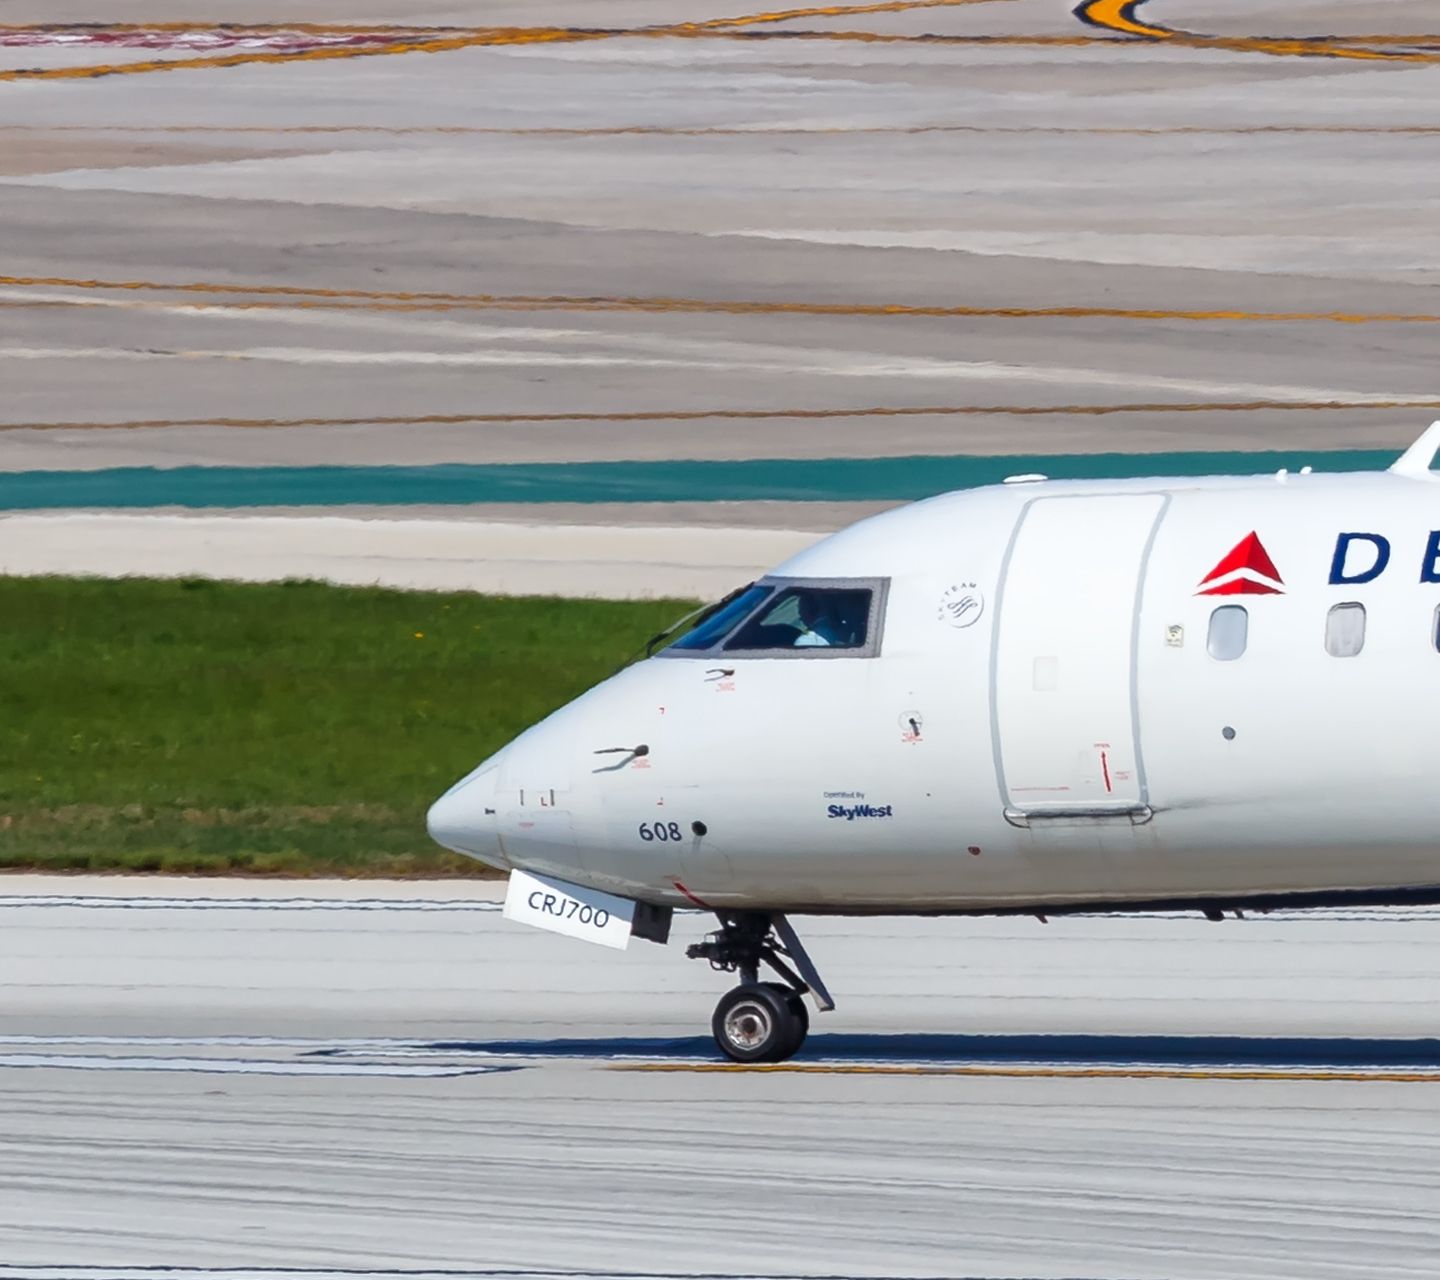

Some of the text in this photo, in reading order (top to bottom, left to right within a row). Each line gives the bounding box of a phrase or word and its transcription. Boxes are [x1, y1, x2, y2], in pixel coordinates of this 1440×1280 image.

[827, 804, 893, 821] SkyWest
[639, 822, 682, 842] 608
[527, 890, 610, 929] CRJ700
